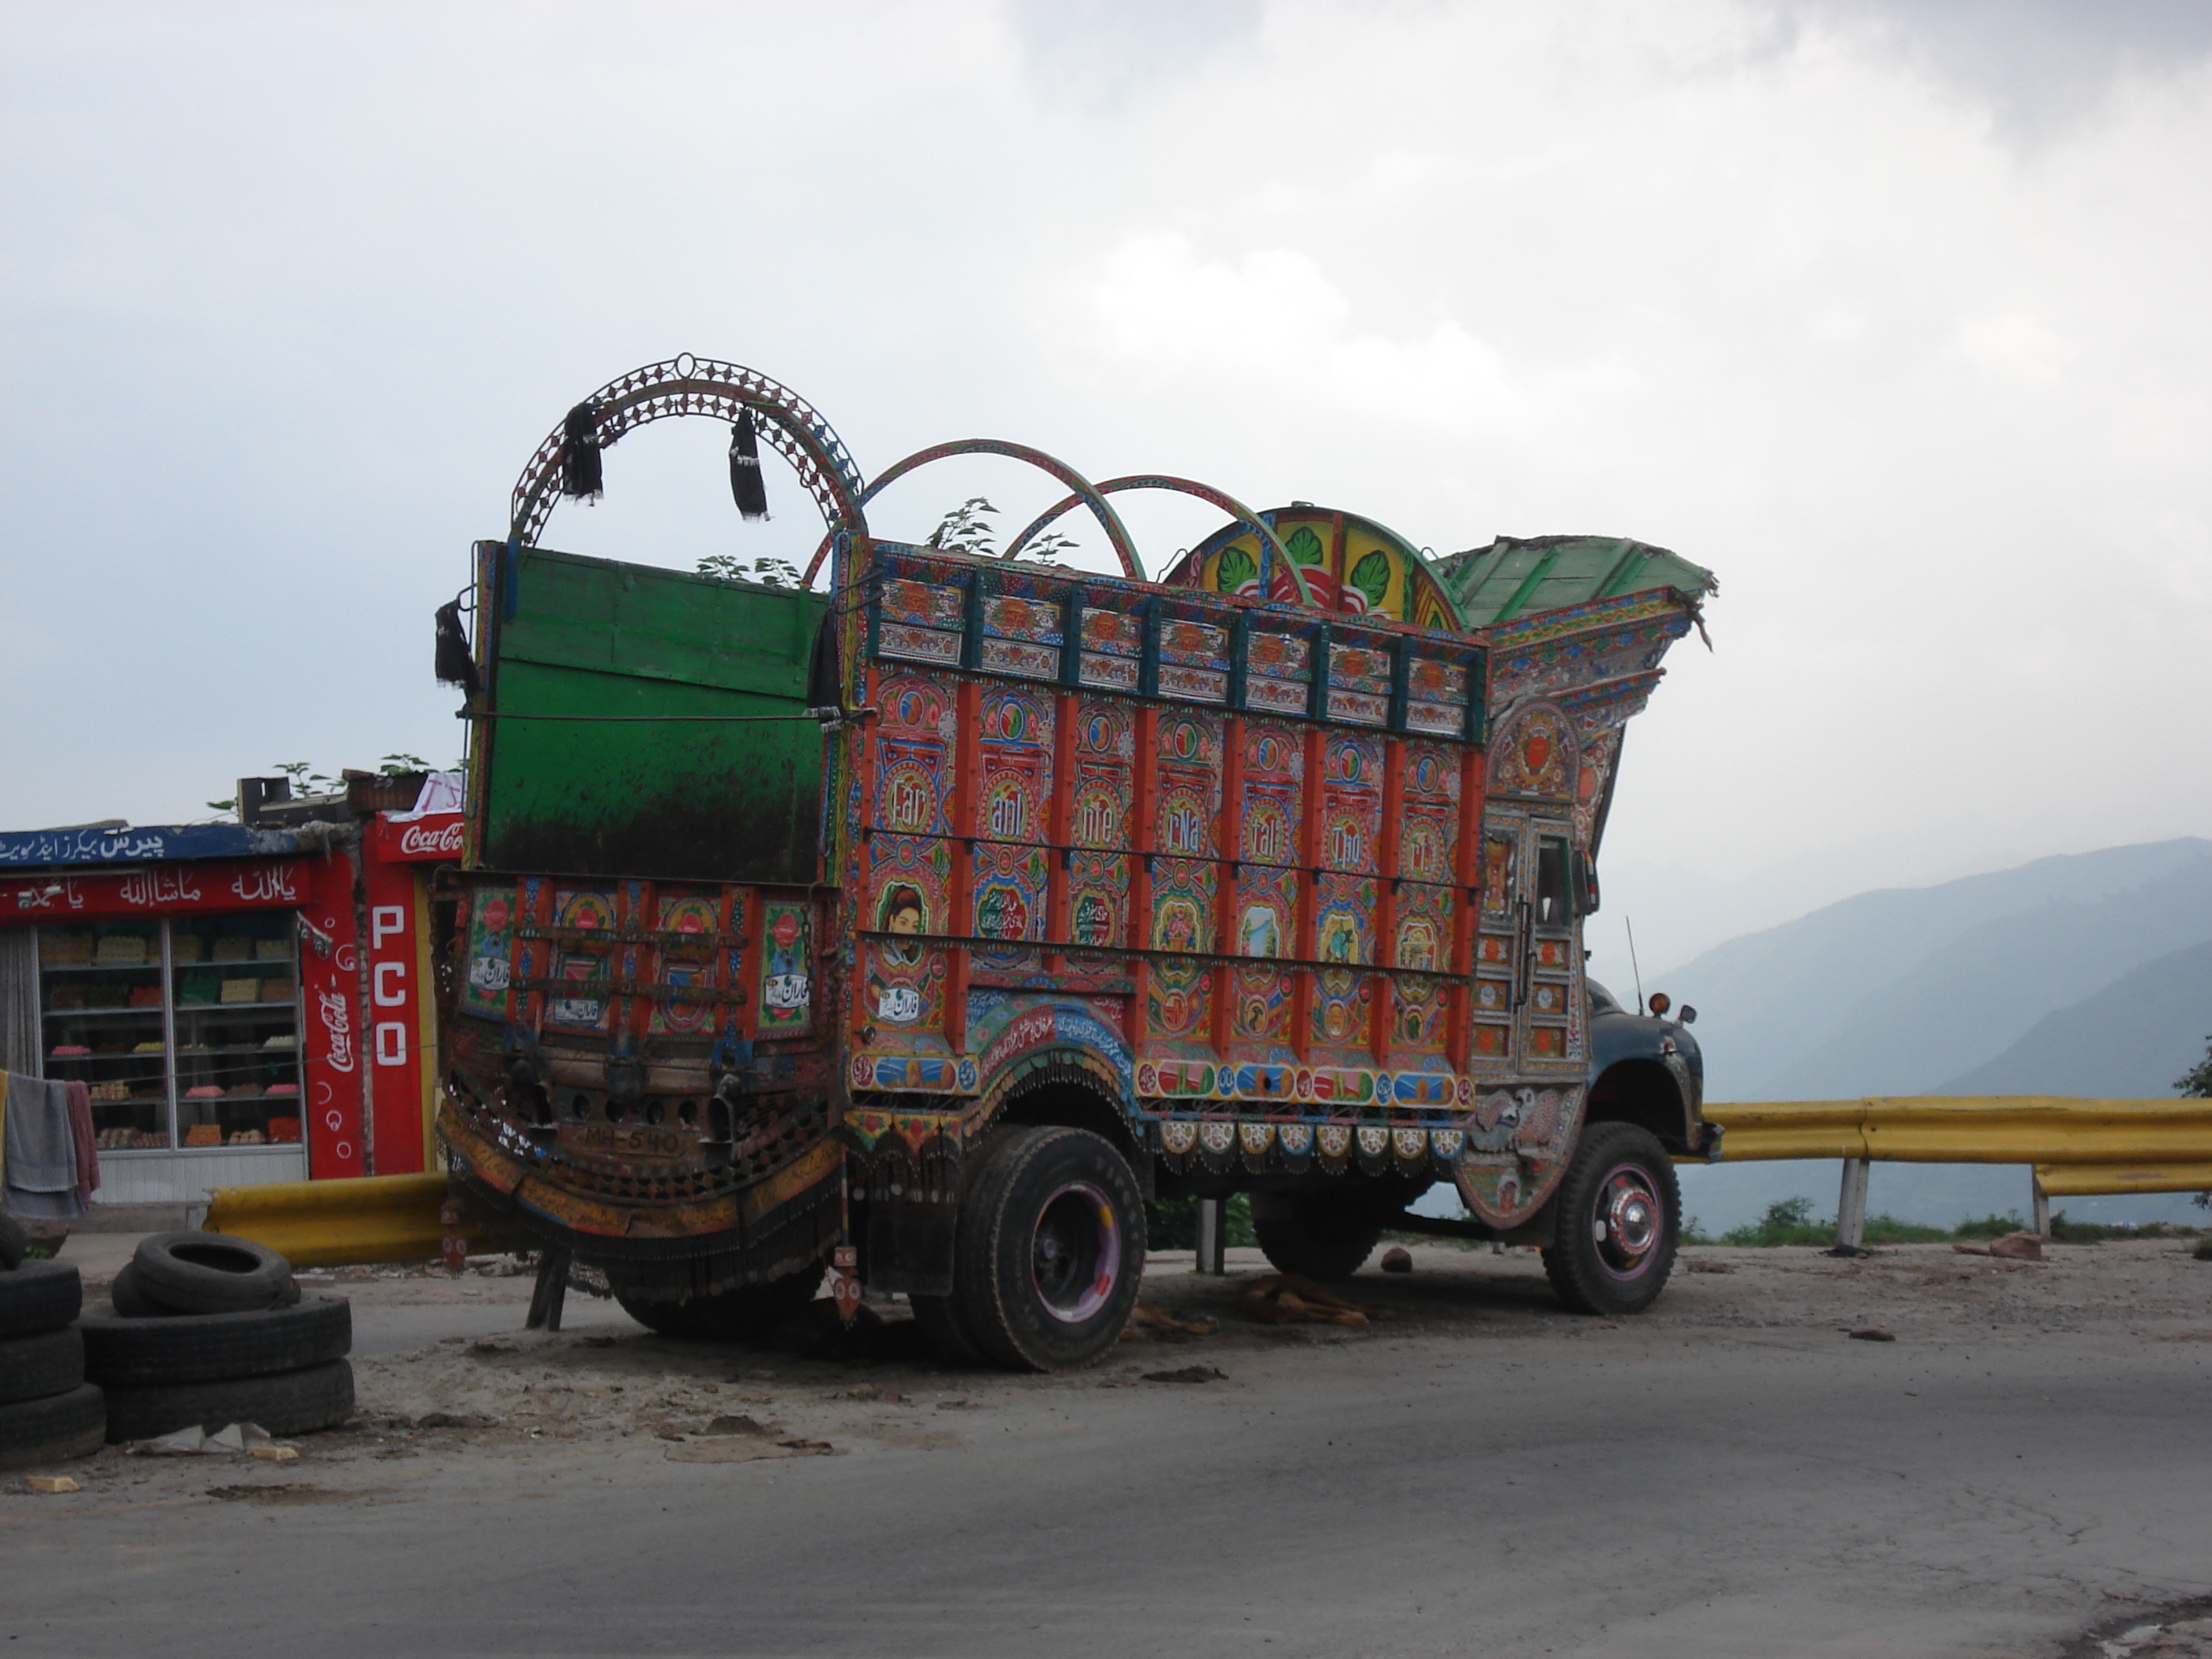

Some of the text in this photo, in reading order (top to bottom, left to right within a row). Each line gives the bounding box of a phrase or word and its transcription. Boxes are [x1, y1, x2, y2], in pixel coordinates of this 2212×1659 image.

[401, 822, 465, 855] Coca-Co
[372, 905, 408, 1067] PCO
[893, 995, 918, 1016] فاران
